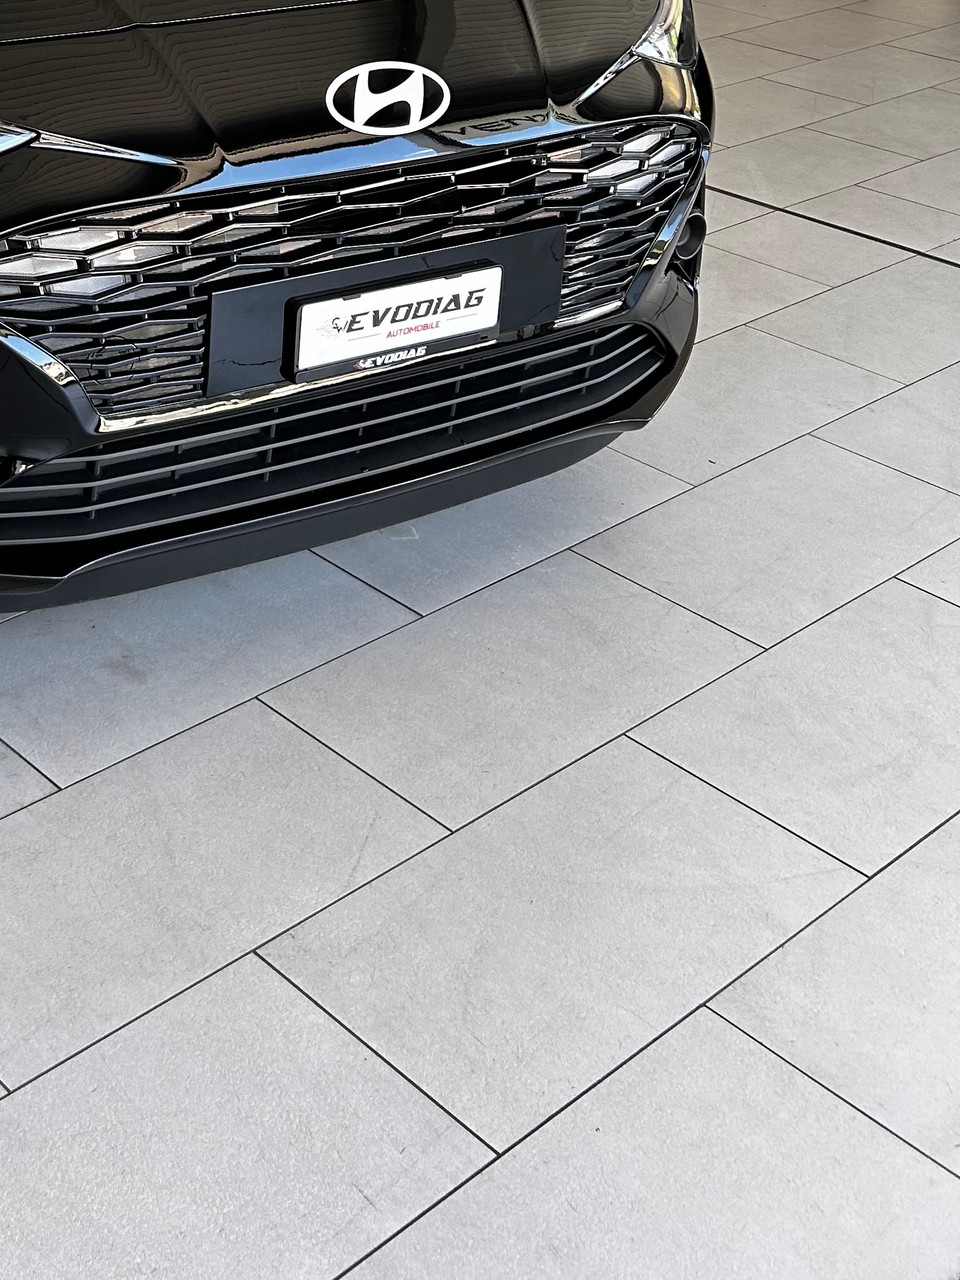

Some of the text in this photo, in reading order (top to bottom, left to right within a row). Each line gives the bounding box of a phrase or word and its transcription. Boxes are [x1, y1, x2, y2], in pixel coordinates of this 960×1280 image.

[346, 287, 486, 333] EVODIAG
[386, 321, 441, 339] AUTOMOBILE
[365, 345, 428, 368] EVODIAG
